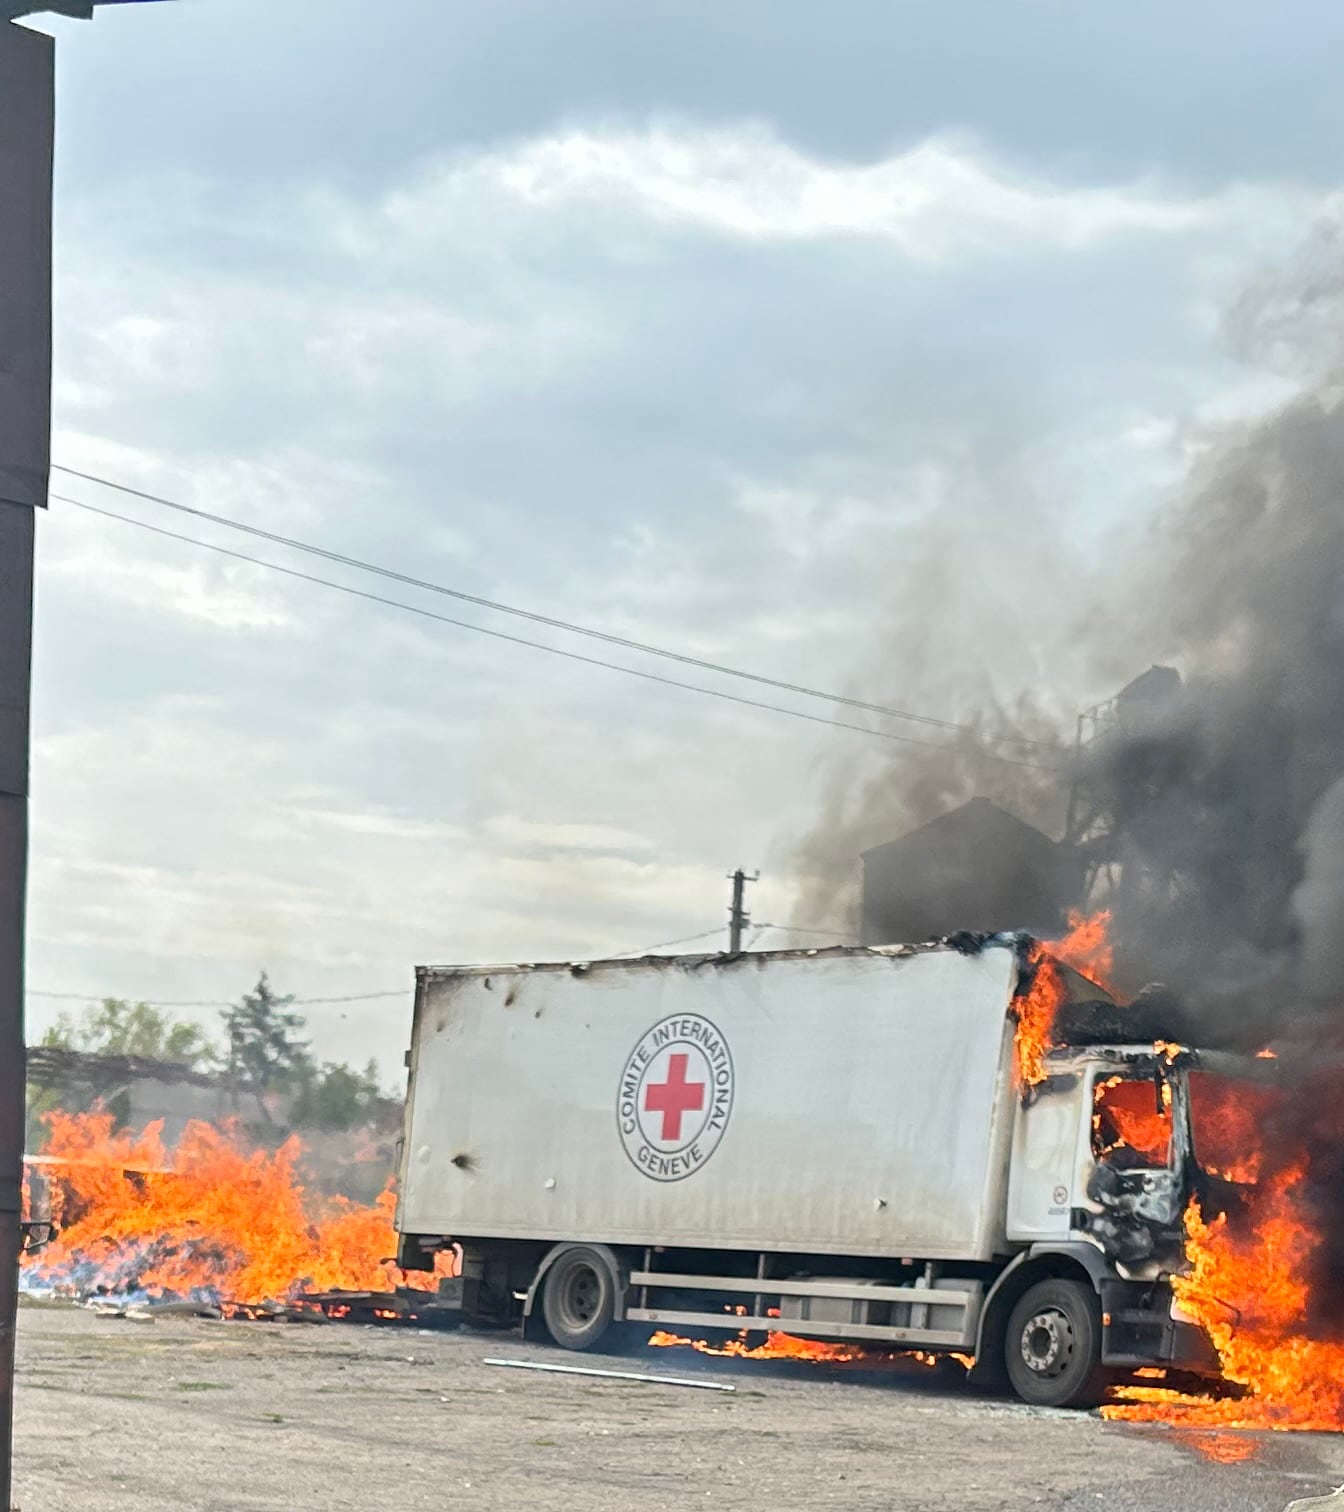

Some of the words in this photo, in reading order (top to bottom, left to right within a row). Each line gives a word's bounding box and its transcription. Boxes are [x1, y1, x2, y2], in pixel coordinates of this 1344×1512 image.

[621, 1045, 651, 1135] COMITE
[652, 1019, 730, 1132] INTERNATIONAL
[637, 1143, 703, 1175] GENEVE
